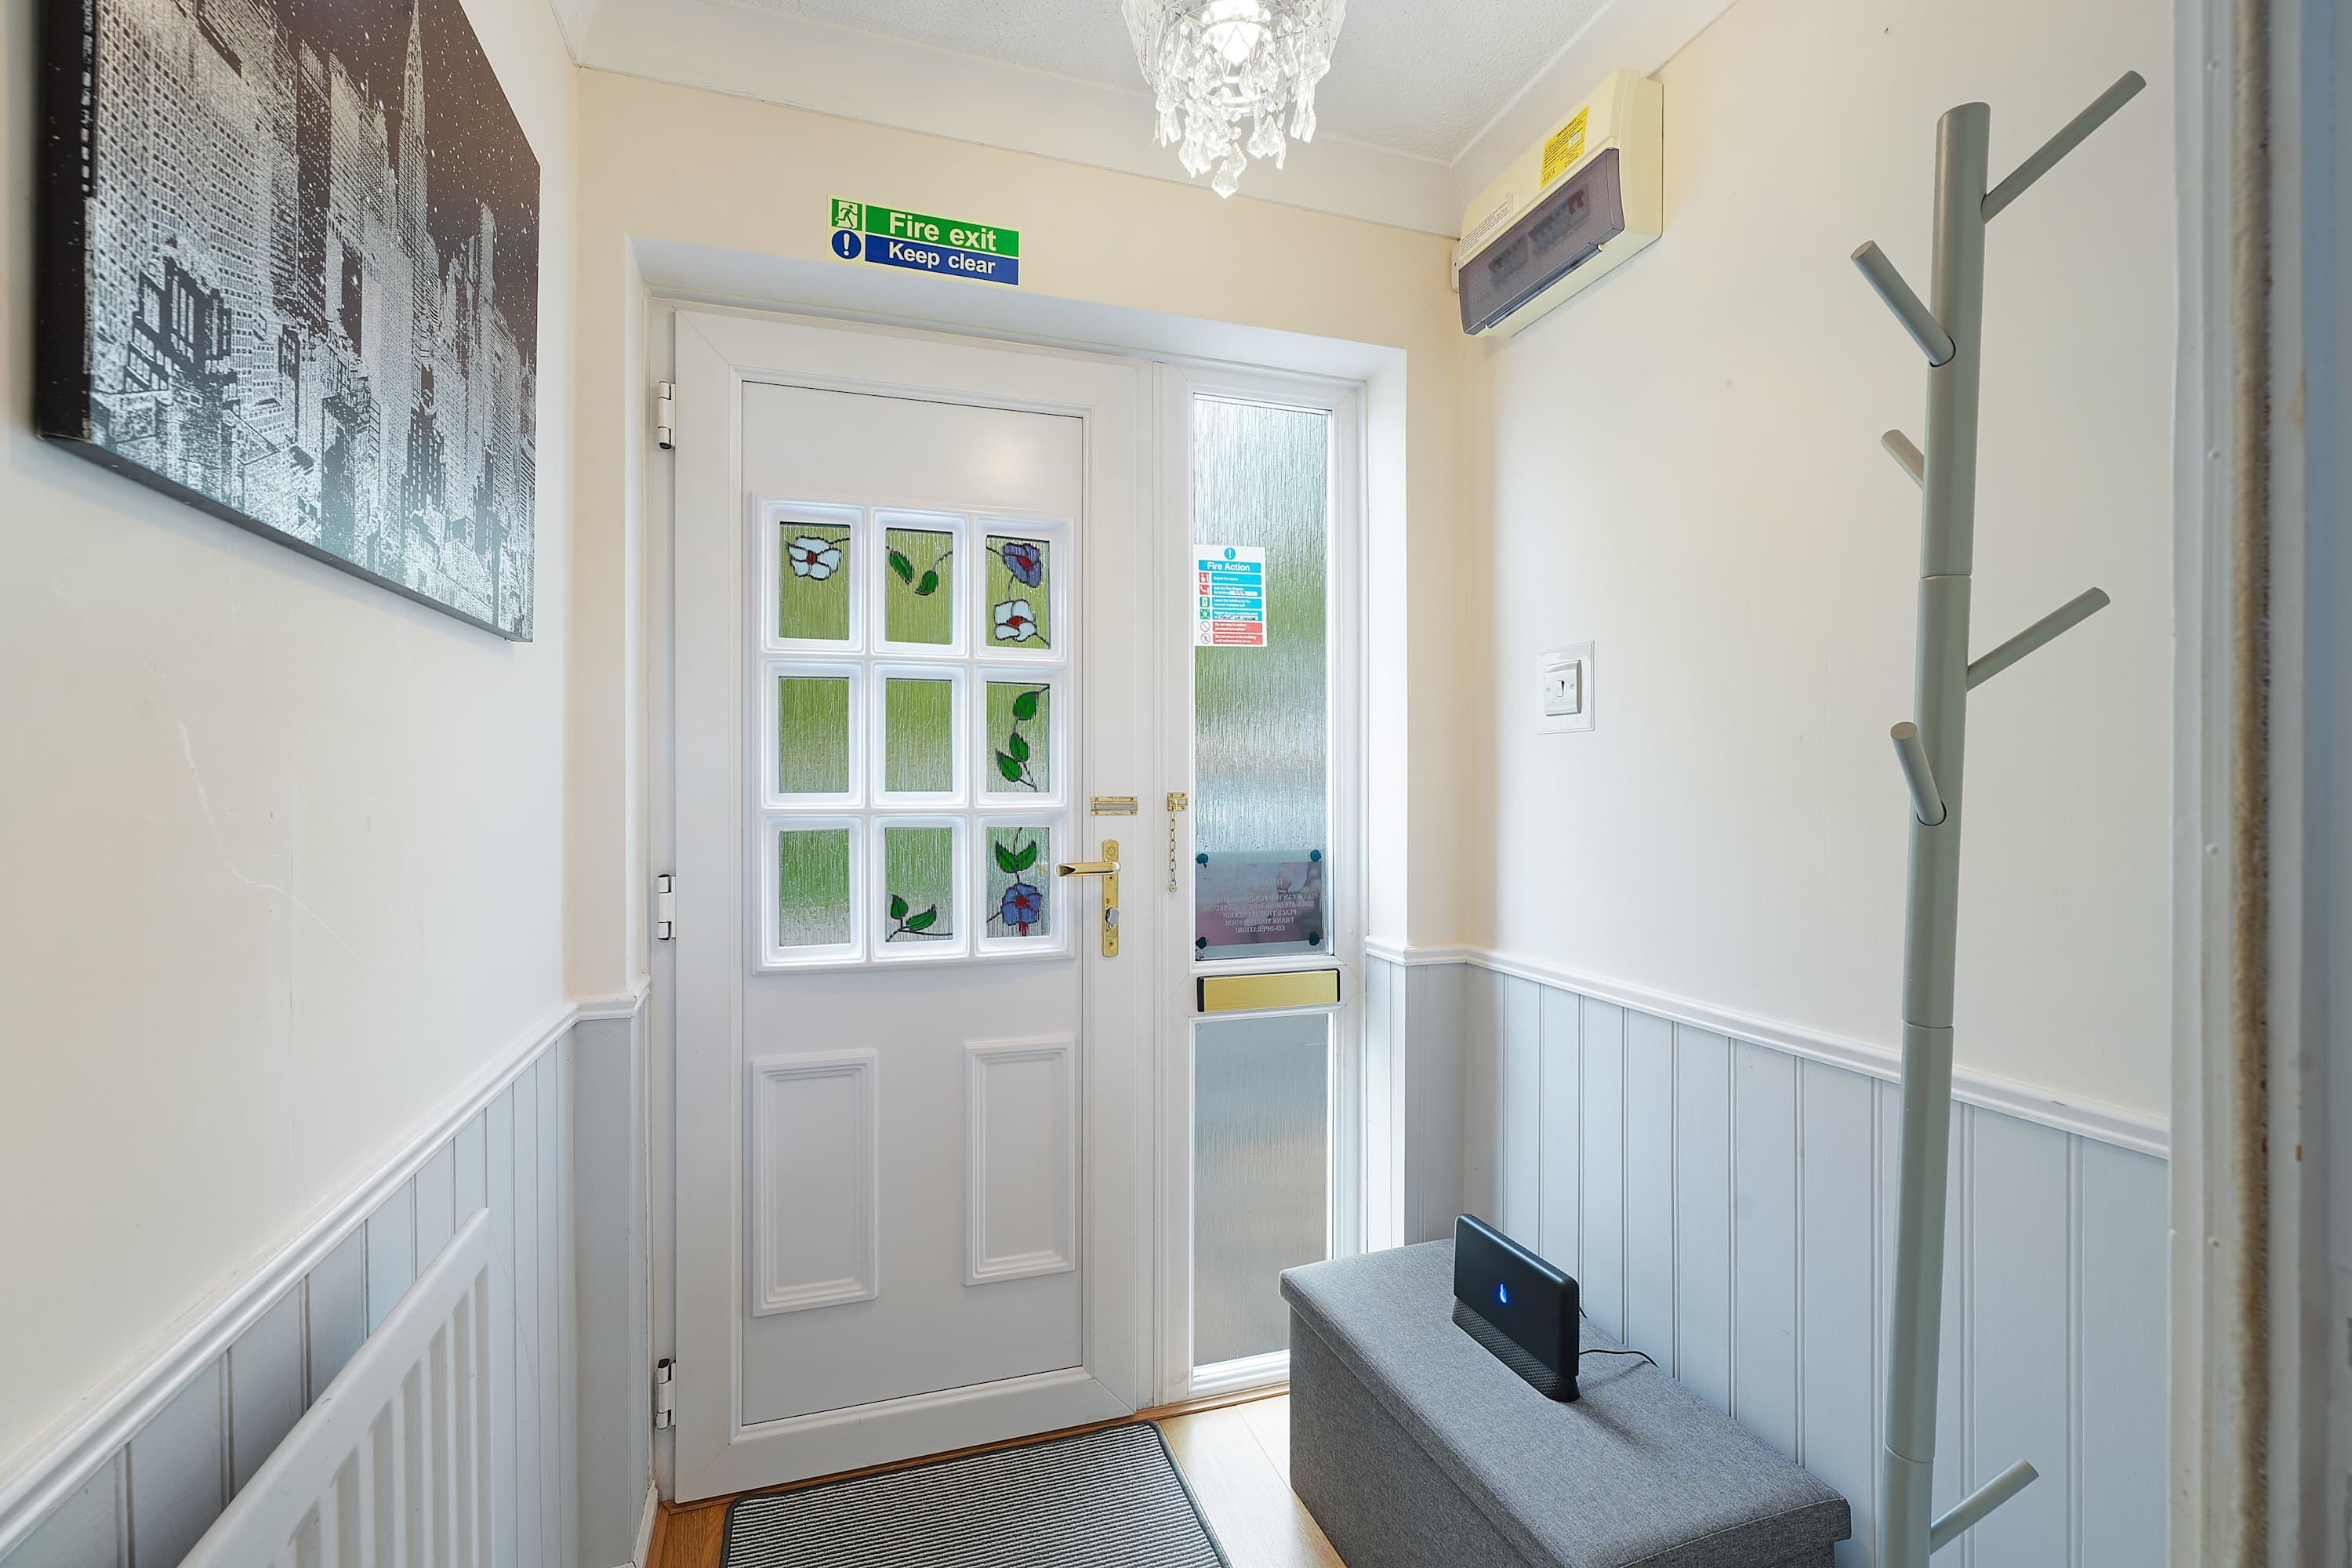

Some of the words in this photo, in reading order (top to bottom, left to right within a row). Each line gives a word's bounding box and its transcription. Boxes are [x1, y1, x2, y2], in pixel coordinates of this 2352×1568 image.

[889, 211, 940, 241] Fire
[949, 227, 996, 252] exit
[888, 241, 940, 269] Keep
[948, 252, 996, 274] clear
[1207, 561, 1222, 570] Fire
[1224, 562, 1250, 572] Action
